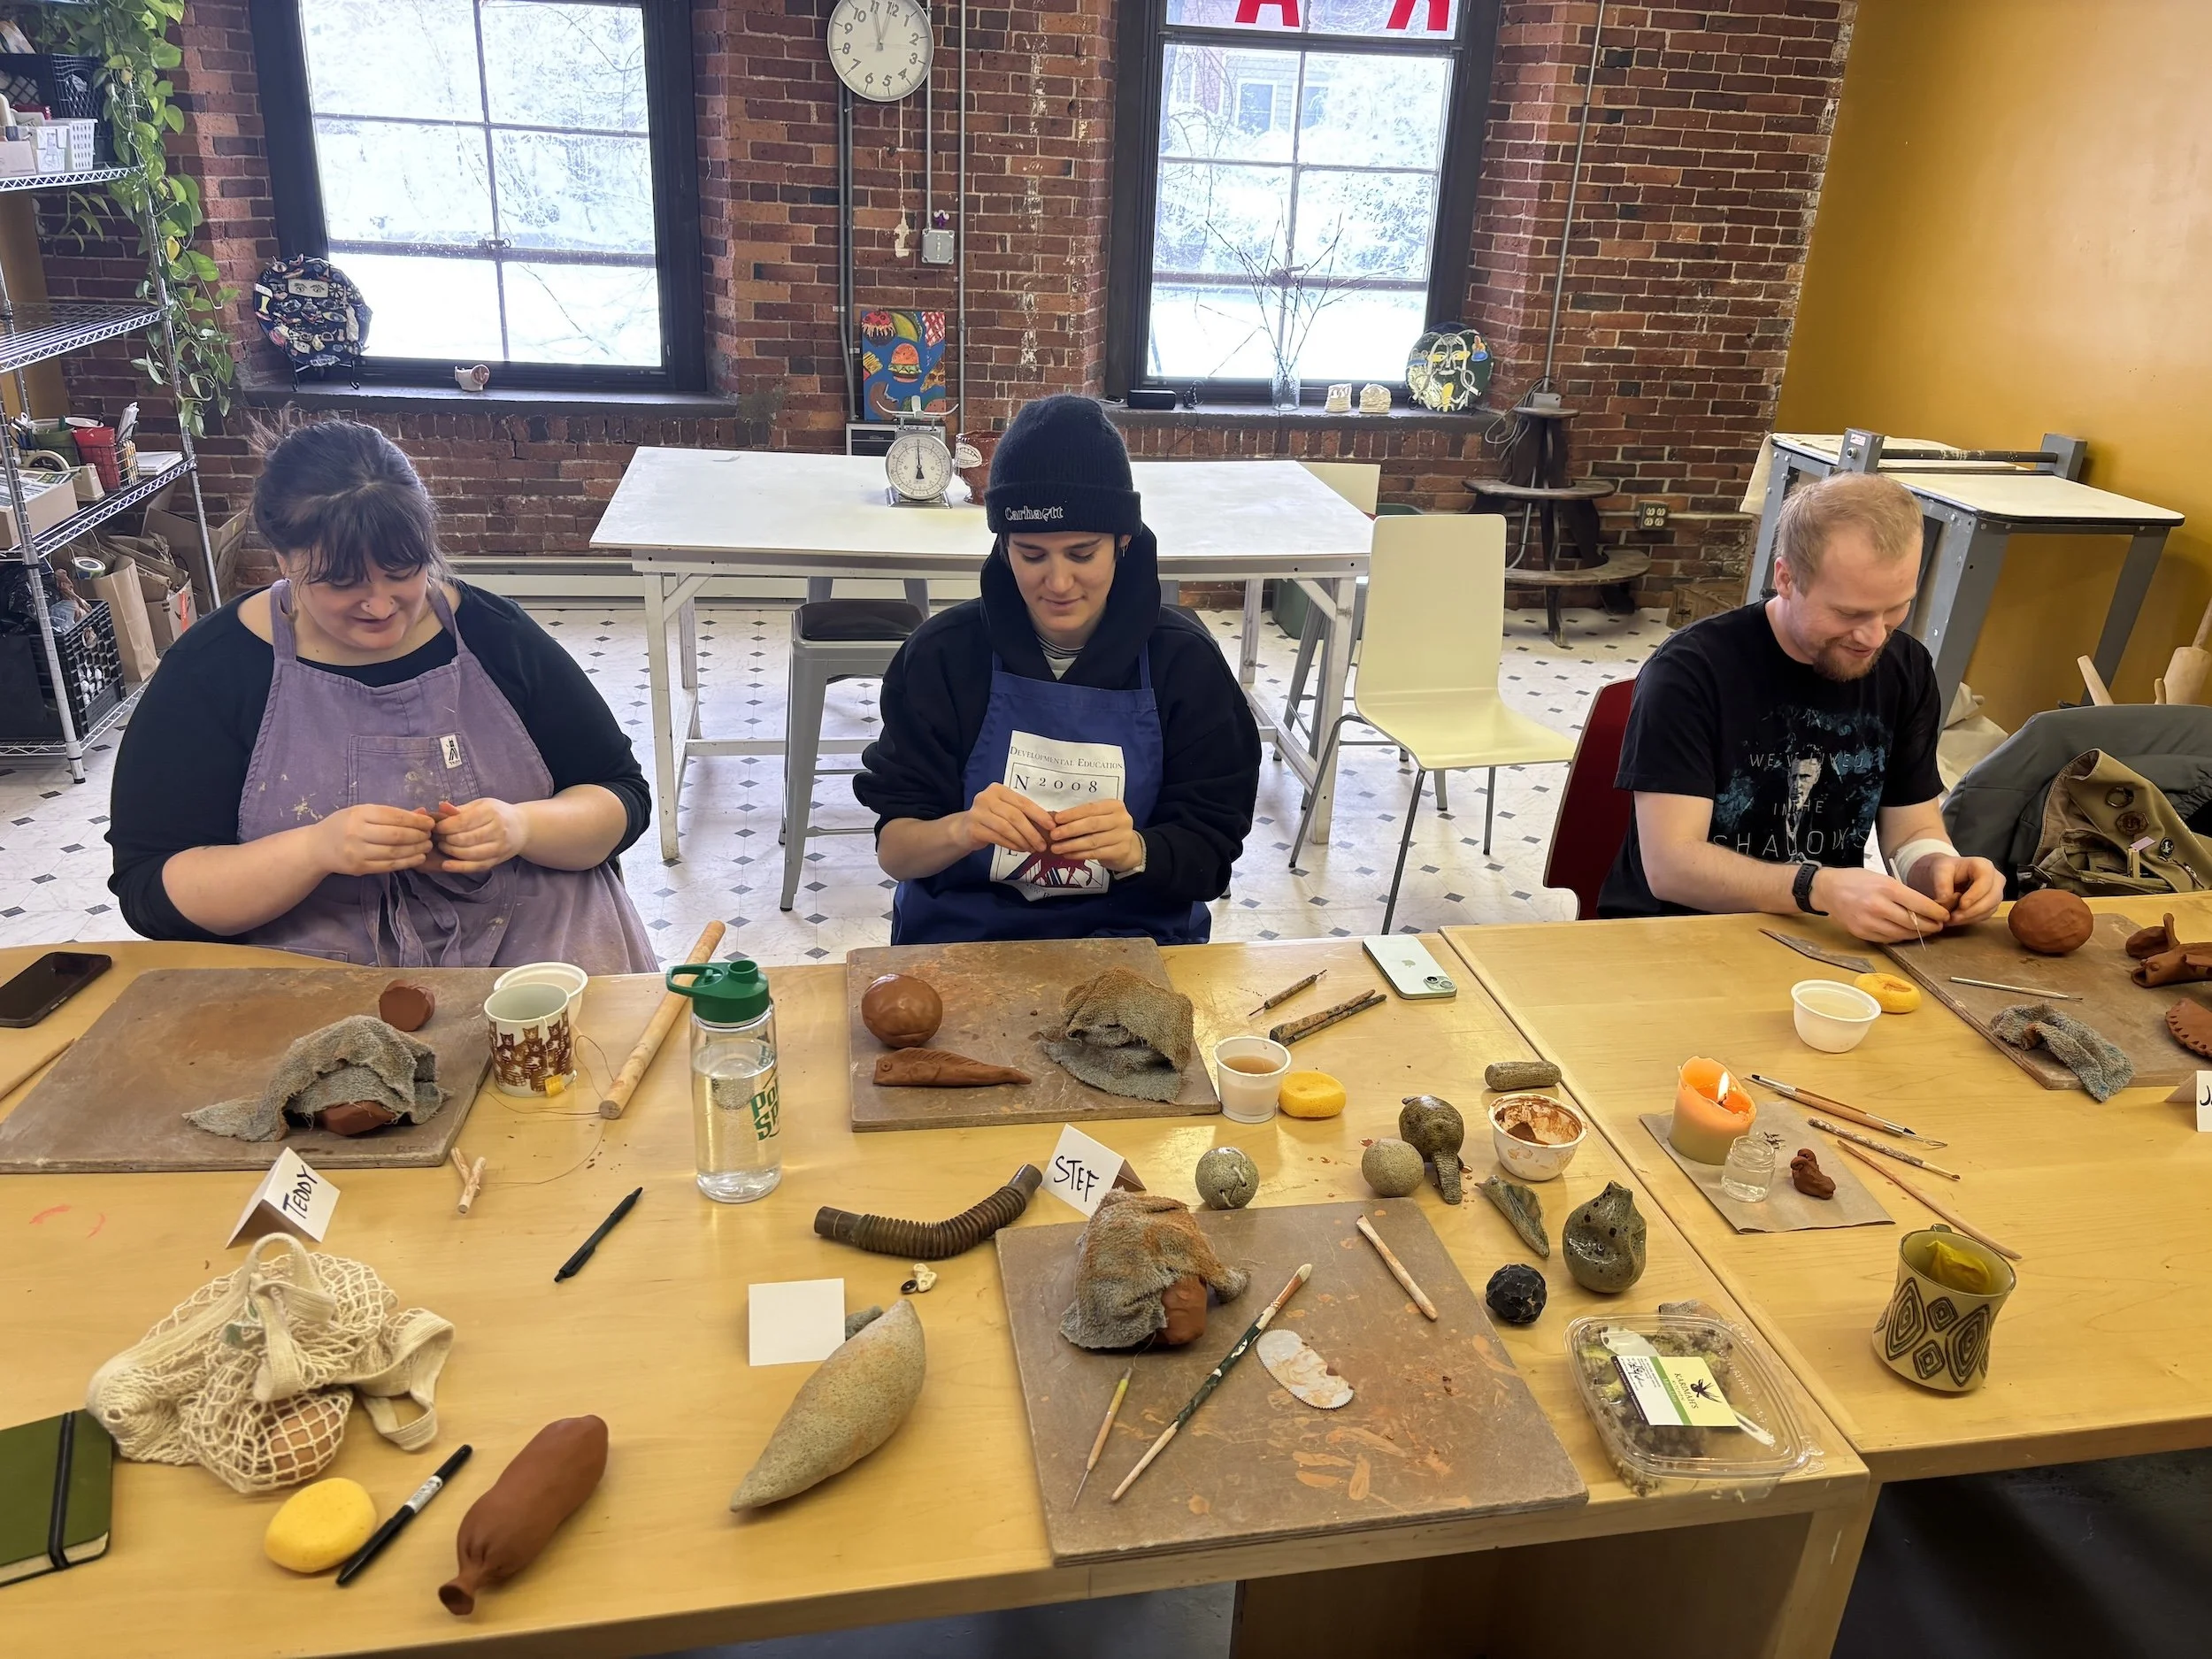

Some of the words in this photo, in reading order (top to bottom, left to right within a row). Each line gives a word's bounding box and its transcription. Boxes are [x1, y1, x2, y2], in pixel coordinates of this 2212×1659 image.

[870, 0, 880, 14] 11
[886, 1, 900, 18] 12
[853, 7, 867, 23] 10
[903, 14, 910, 27] 1
[844, 22, 853, 35] 9
[909, 32, 919, 46] 2
[841, 42, 851, 55] 8
[852, 58, 862, 71] 7
[909, 52, 918, 65] 3
[864, 72, 874, 85] 6
[882, 74, 893, 87] 5
[897, 67, 908, 81] 4
[1004, 505, 1064, 522] Carhartt
[1010, 746, 1075, 766] DEVELOPMENTAL
[1078, 758, 1124, 770] EDUCATION
[1054, 1155, 1100, 1202] STEF
[282, 1164, 318, 1219] TEDDY
[1674, 1372, 1699, 1409] KARIMAH'S
